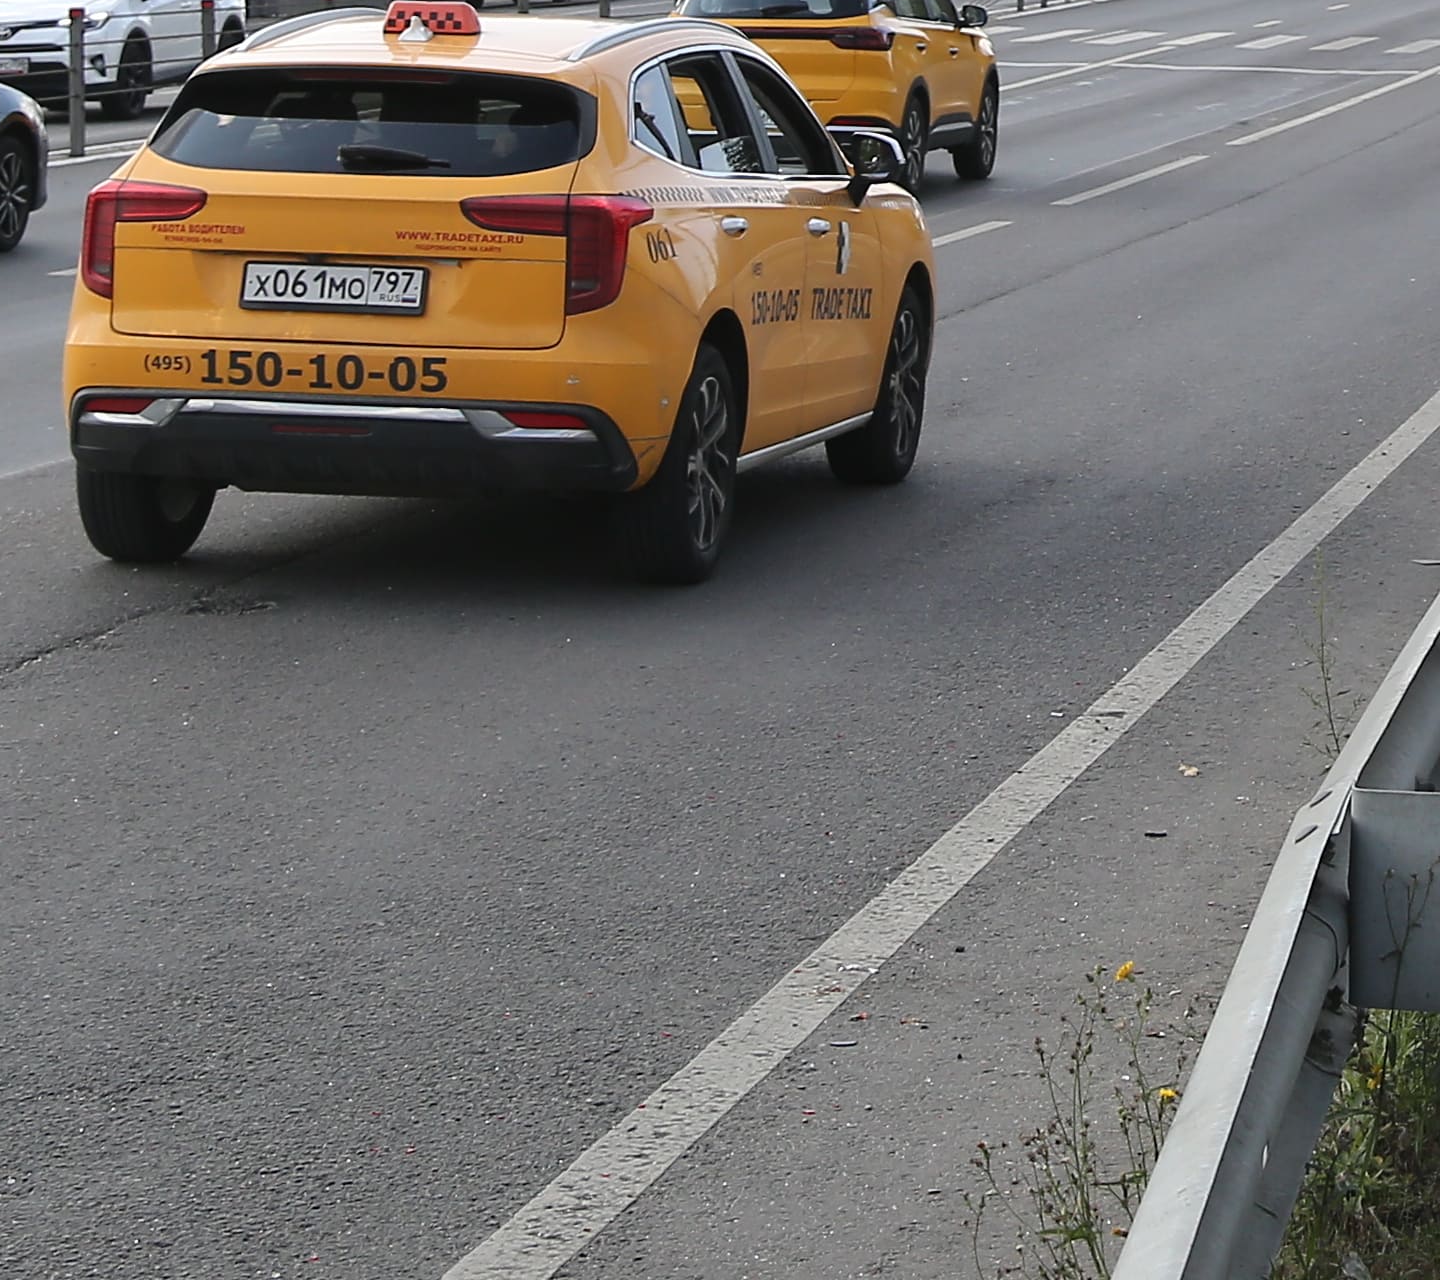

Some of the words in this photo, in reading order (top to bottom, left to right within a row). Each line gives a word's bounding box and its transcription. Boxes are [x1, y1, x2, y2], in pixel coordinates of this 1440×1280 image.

[395, 230, 525, 244] WWW.TRADETAXI.RU
[646, 228, 678, 263] 061
[371, 271, 415, 295] 797
[379, 293, 401, 303] RUS
[751, 289, 801, 325] 150-10-05
[811, 288, 844, 320] TRADE
[847, 288, 873, 320] TAXI
[144, 353, 192, 374] (495)
[200, 349, 448, 392] 150-10-05
